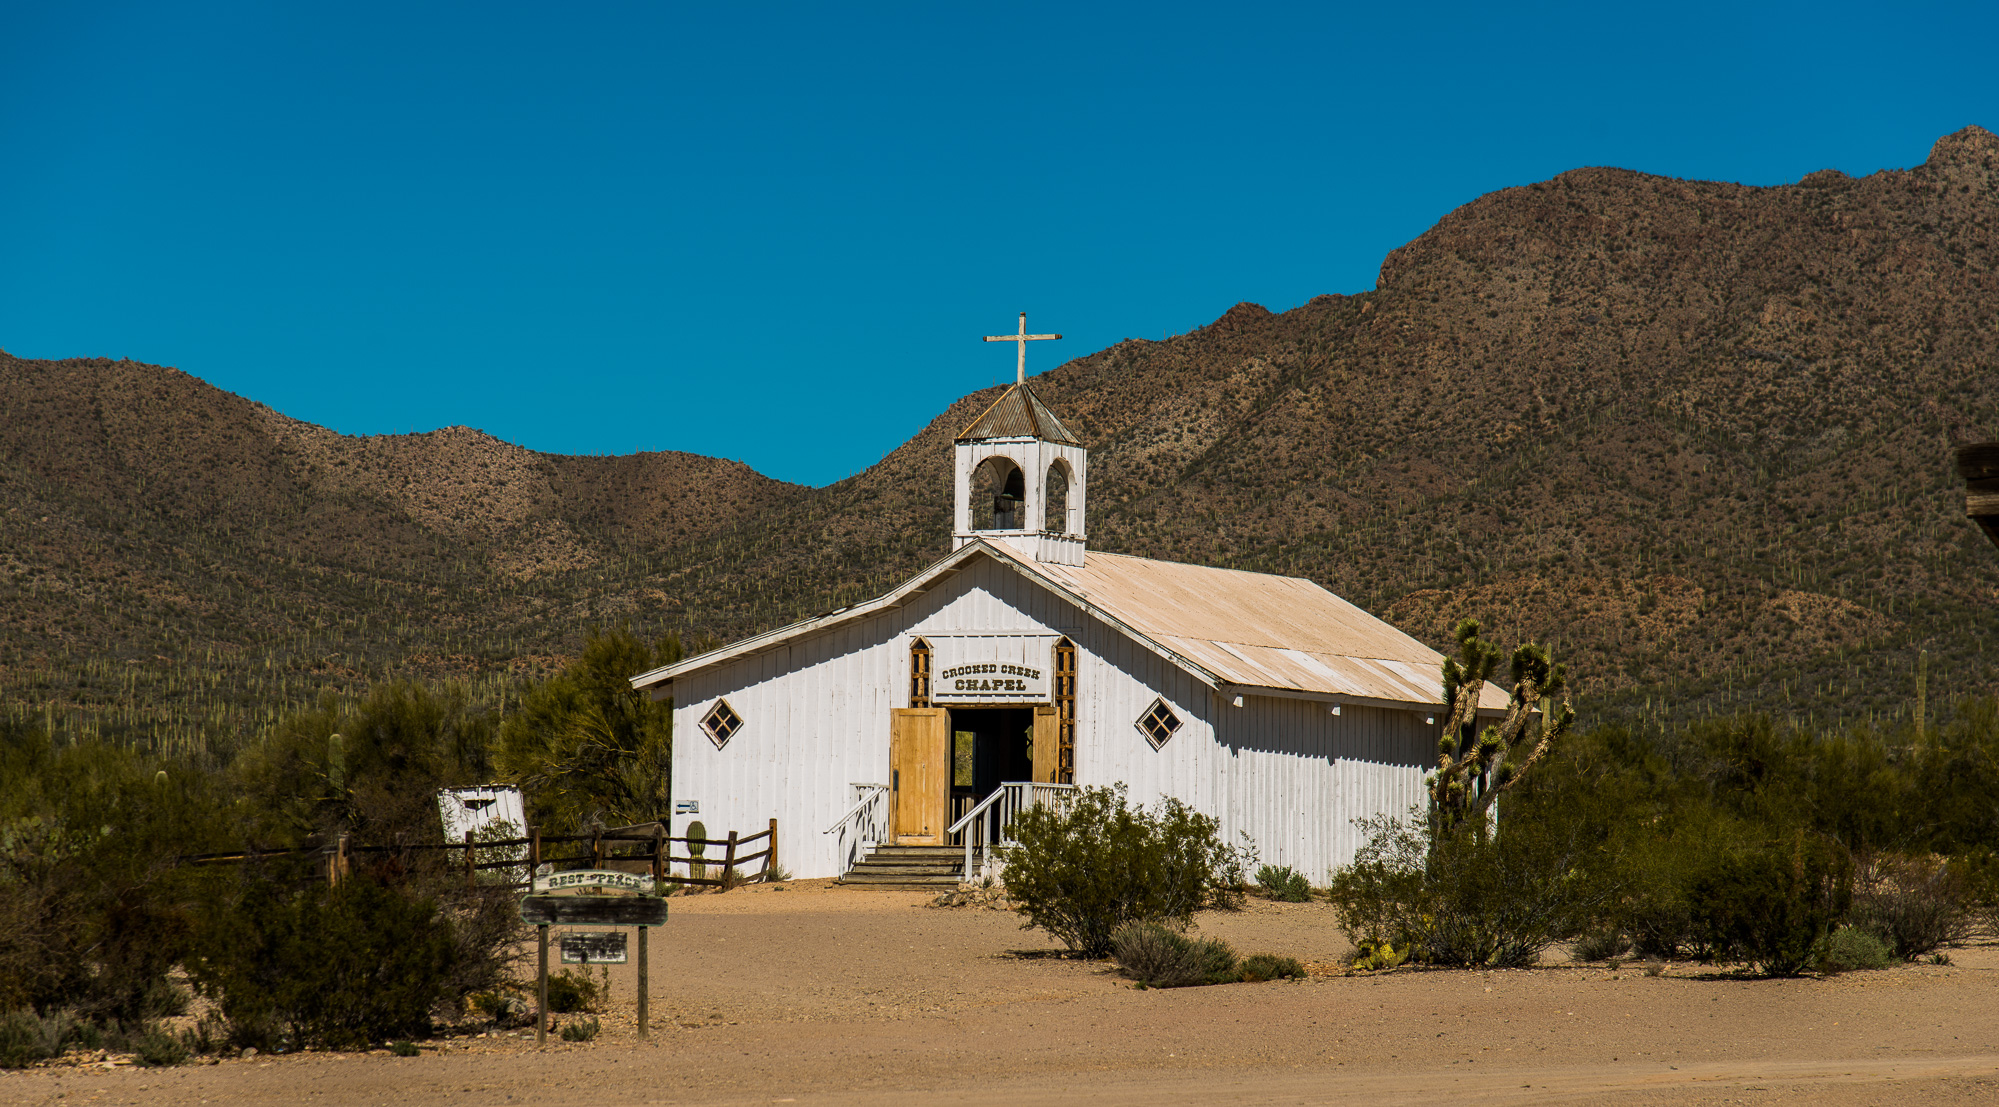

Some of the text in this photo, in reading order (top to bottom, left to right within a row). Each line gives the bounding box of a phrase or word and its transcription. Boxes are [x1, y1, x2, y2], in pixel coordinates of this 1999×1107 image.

[942, 664, 1041, 680] CROOKED CREEK
[955, 679, 1026, 691] CHAPEL
[549, 874, 584, 887] REST
[598, 873, 640, 888] PEACE
